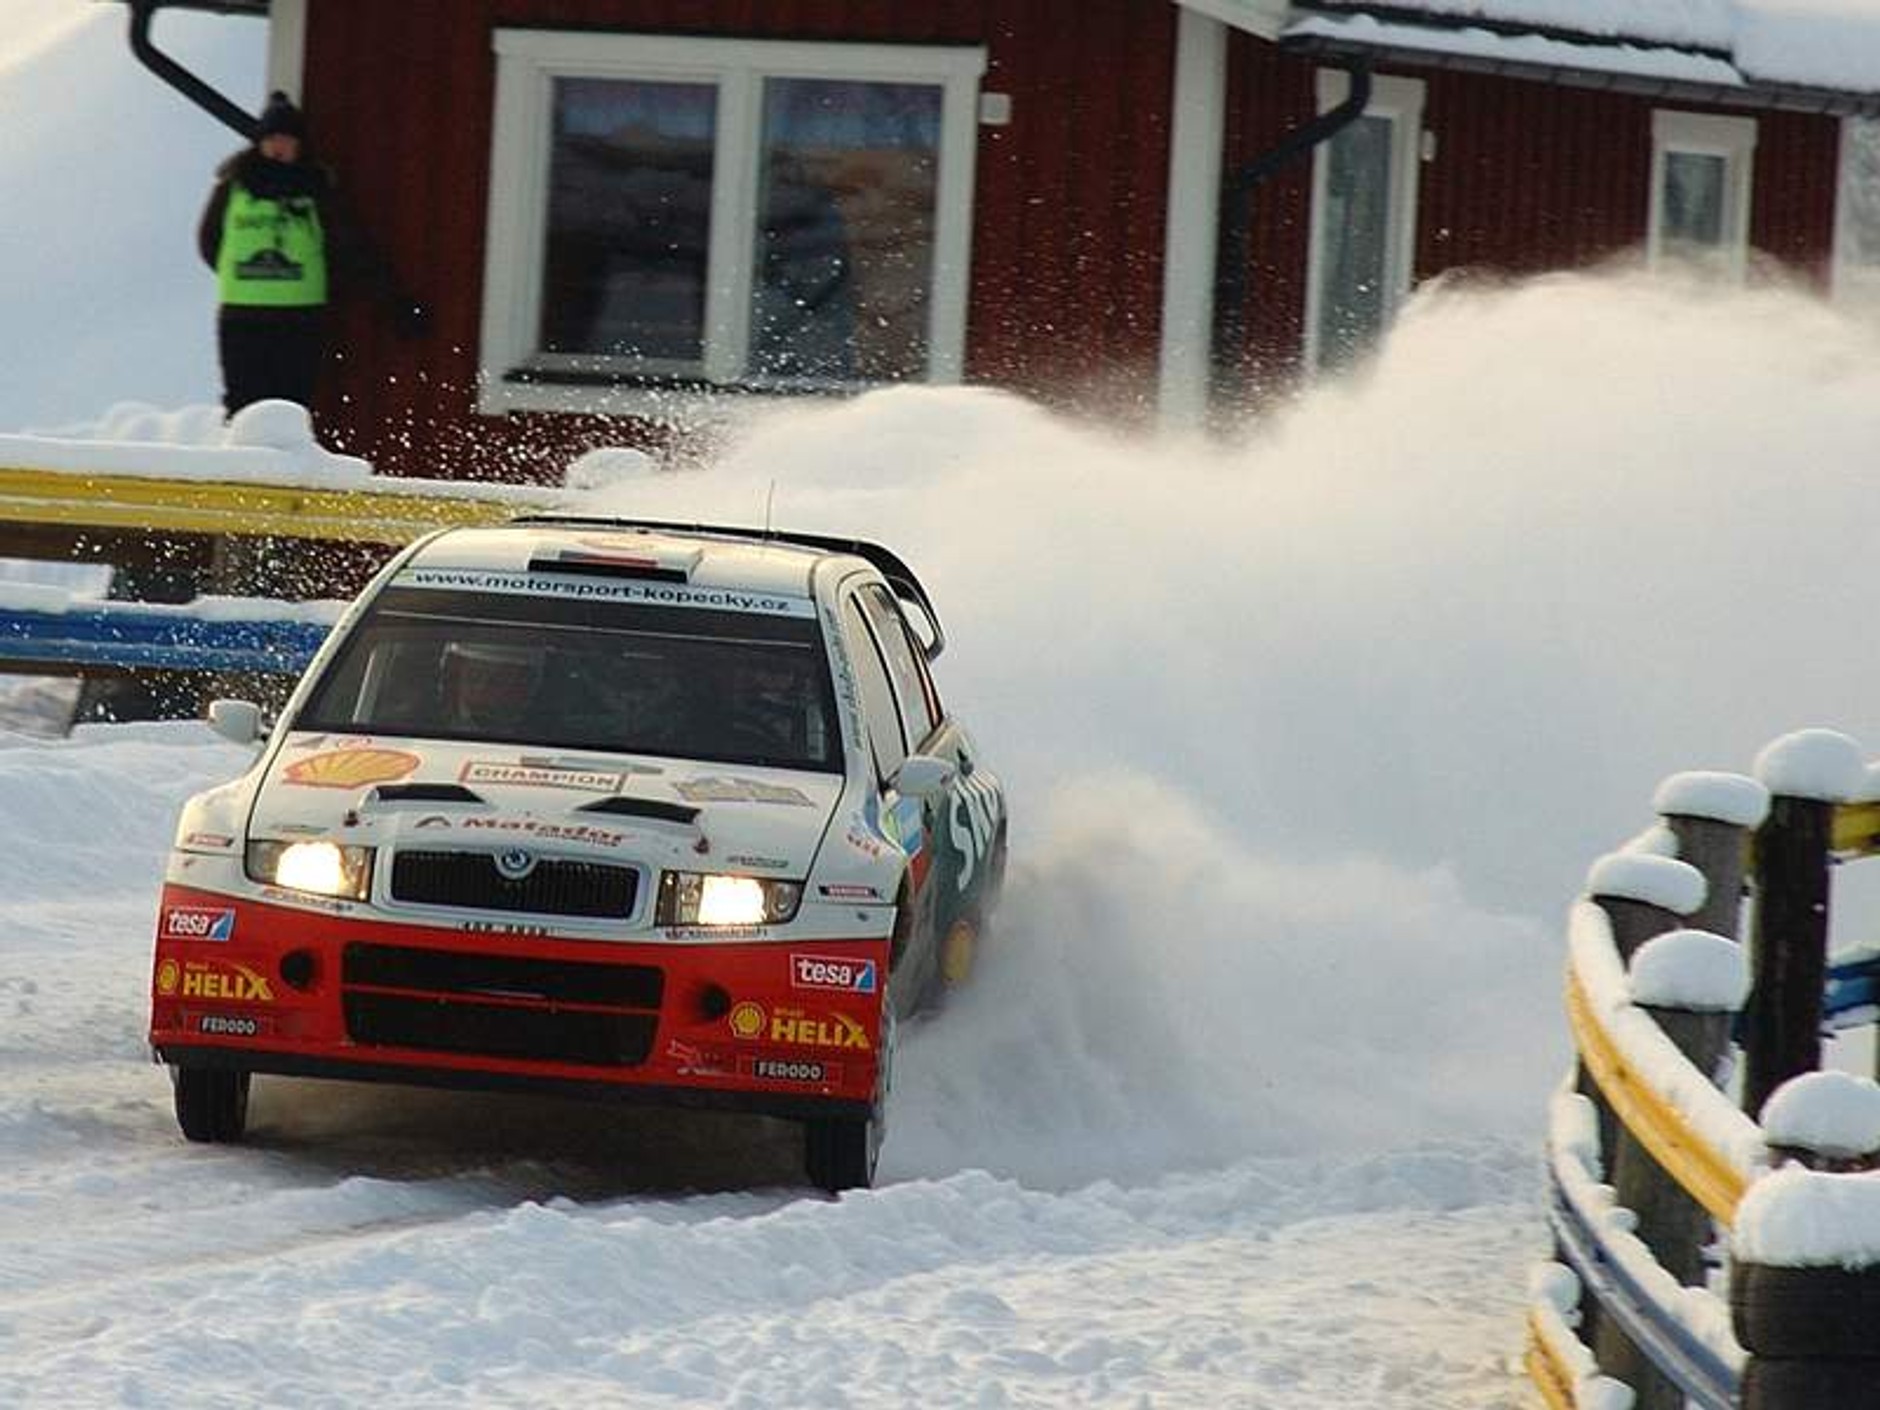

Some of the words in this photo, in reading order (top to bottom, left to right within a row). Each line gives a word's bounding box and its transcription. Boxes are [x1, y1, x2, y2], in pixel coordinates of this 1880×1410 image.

[415, 571, 791, 613] www.motorsport-kopecky.cz
[474, 767, 616, 787] CHAMPION
[168, 908, 209, 935] tesa
[182, 964, 275, 1001] HELIX
[797, 957, 851, 985] tesa
[202, 1016, 256, 1035] FERODO
[770, 1012, 871, 1049] HELIX
[758, 1060, 823, 1081] FERODO
